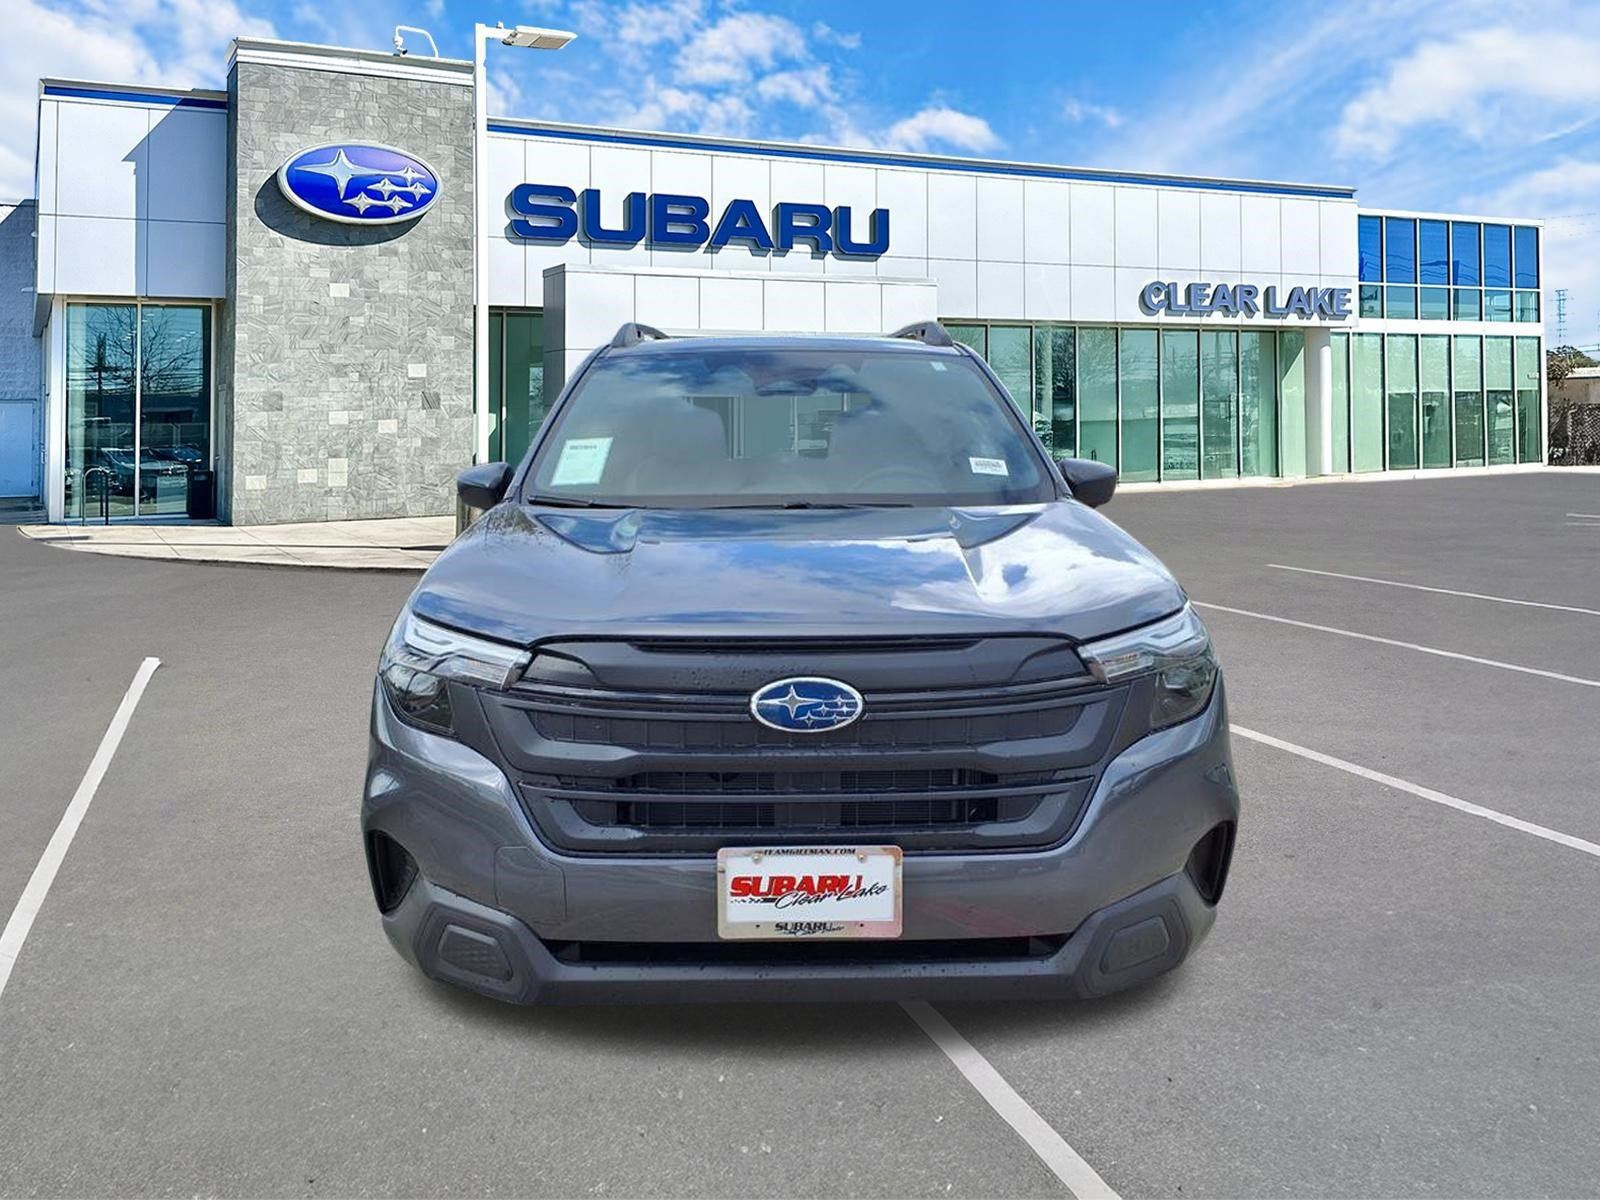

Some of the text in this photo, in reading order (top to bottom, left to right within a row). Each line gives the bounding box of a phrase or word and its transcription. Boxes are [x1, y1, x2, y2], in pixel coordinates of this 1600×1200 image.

[506, 183, 890, 257] SUBARU
[1140, 281, 1352, 320] CLEAR LAKE
[730, 876, 863, 897] SUBARU
[774, 883, 888, 909] Clear Lake
[775, 921, 833, 931] SUBARU
